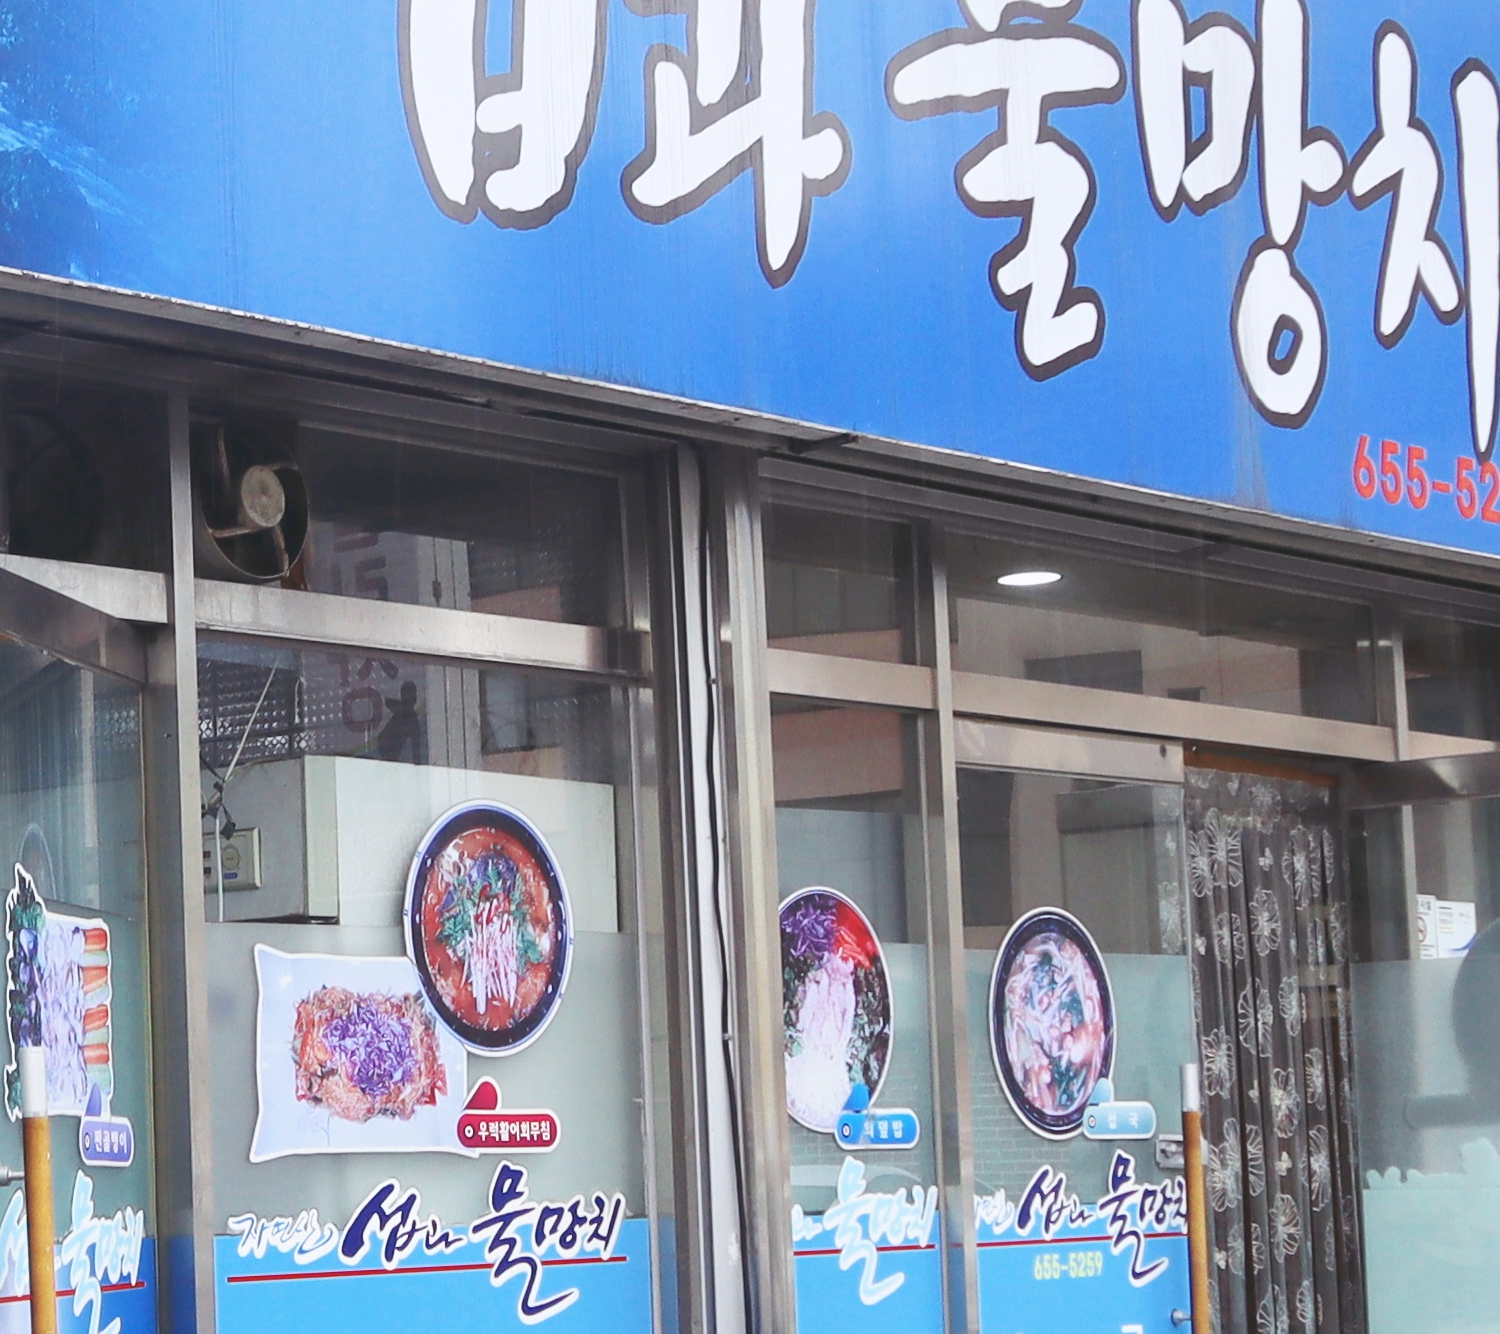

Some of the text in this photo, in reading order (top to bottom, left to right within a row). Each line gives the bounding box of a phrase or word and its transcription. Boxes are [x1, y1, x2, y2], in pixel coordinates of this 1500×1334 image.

[477, 1120, 552, 1142] 우럭활어회무침
[471, 1163, 622, 1317] 물망치
[1033, 1252, 1103, 1281] 655-5259
